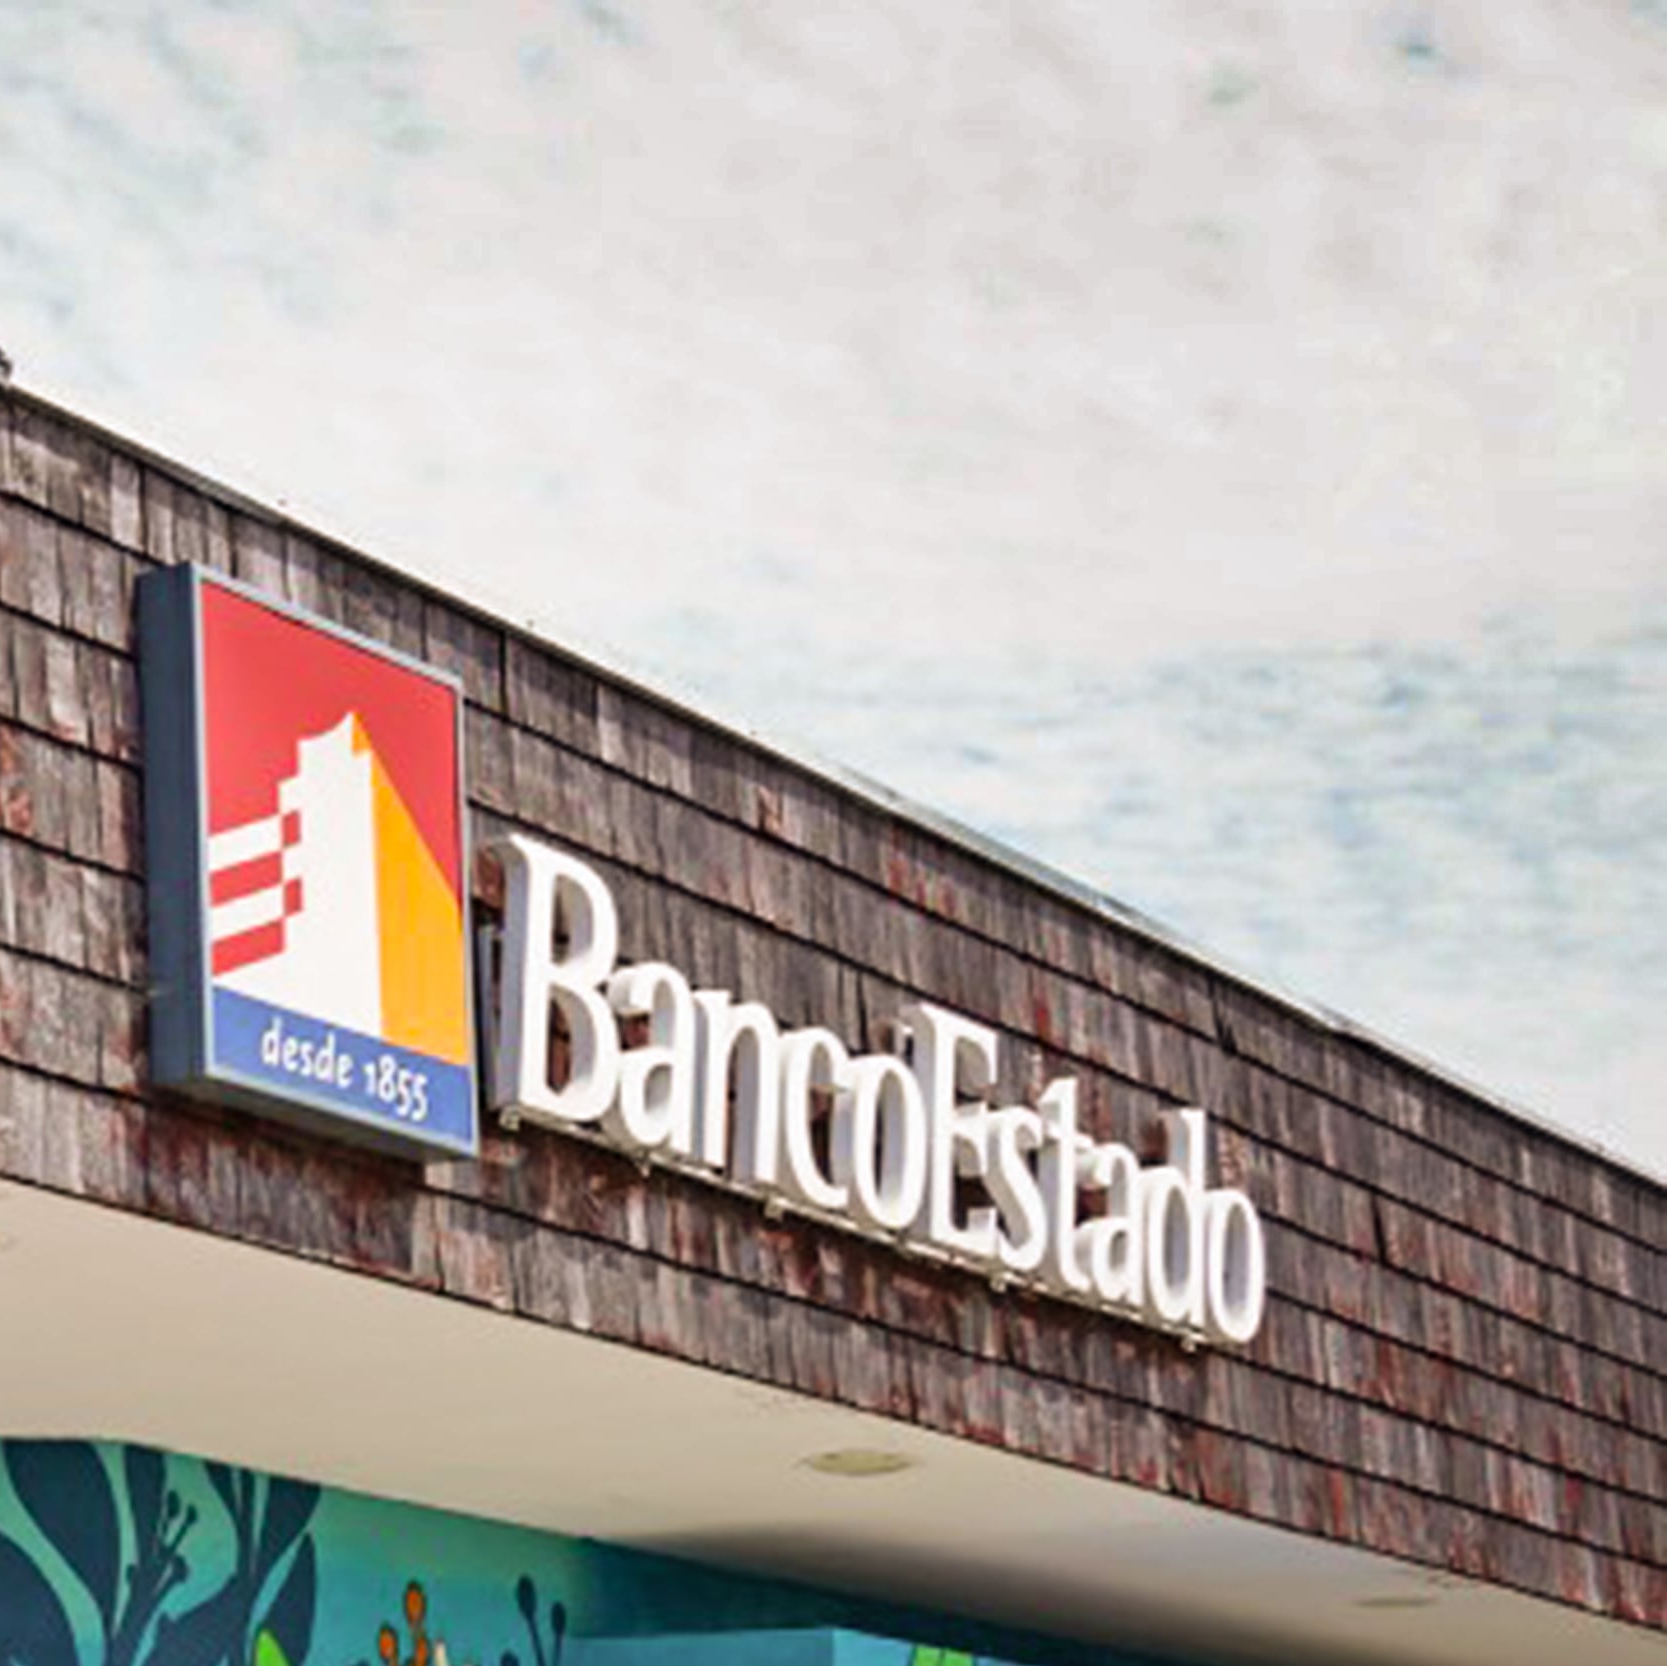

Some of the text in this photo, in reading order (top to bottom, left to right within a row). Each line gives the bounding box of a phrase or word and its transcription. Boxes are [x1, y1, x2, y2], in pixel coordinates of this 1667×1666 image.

[261, 1016, 428, 1121] desde 1855
[489, 832, 1267, 1346] BancoEstado
